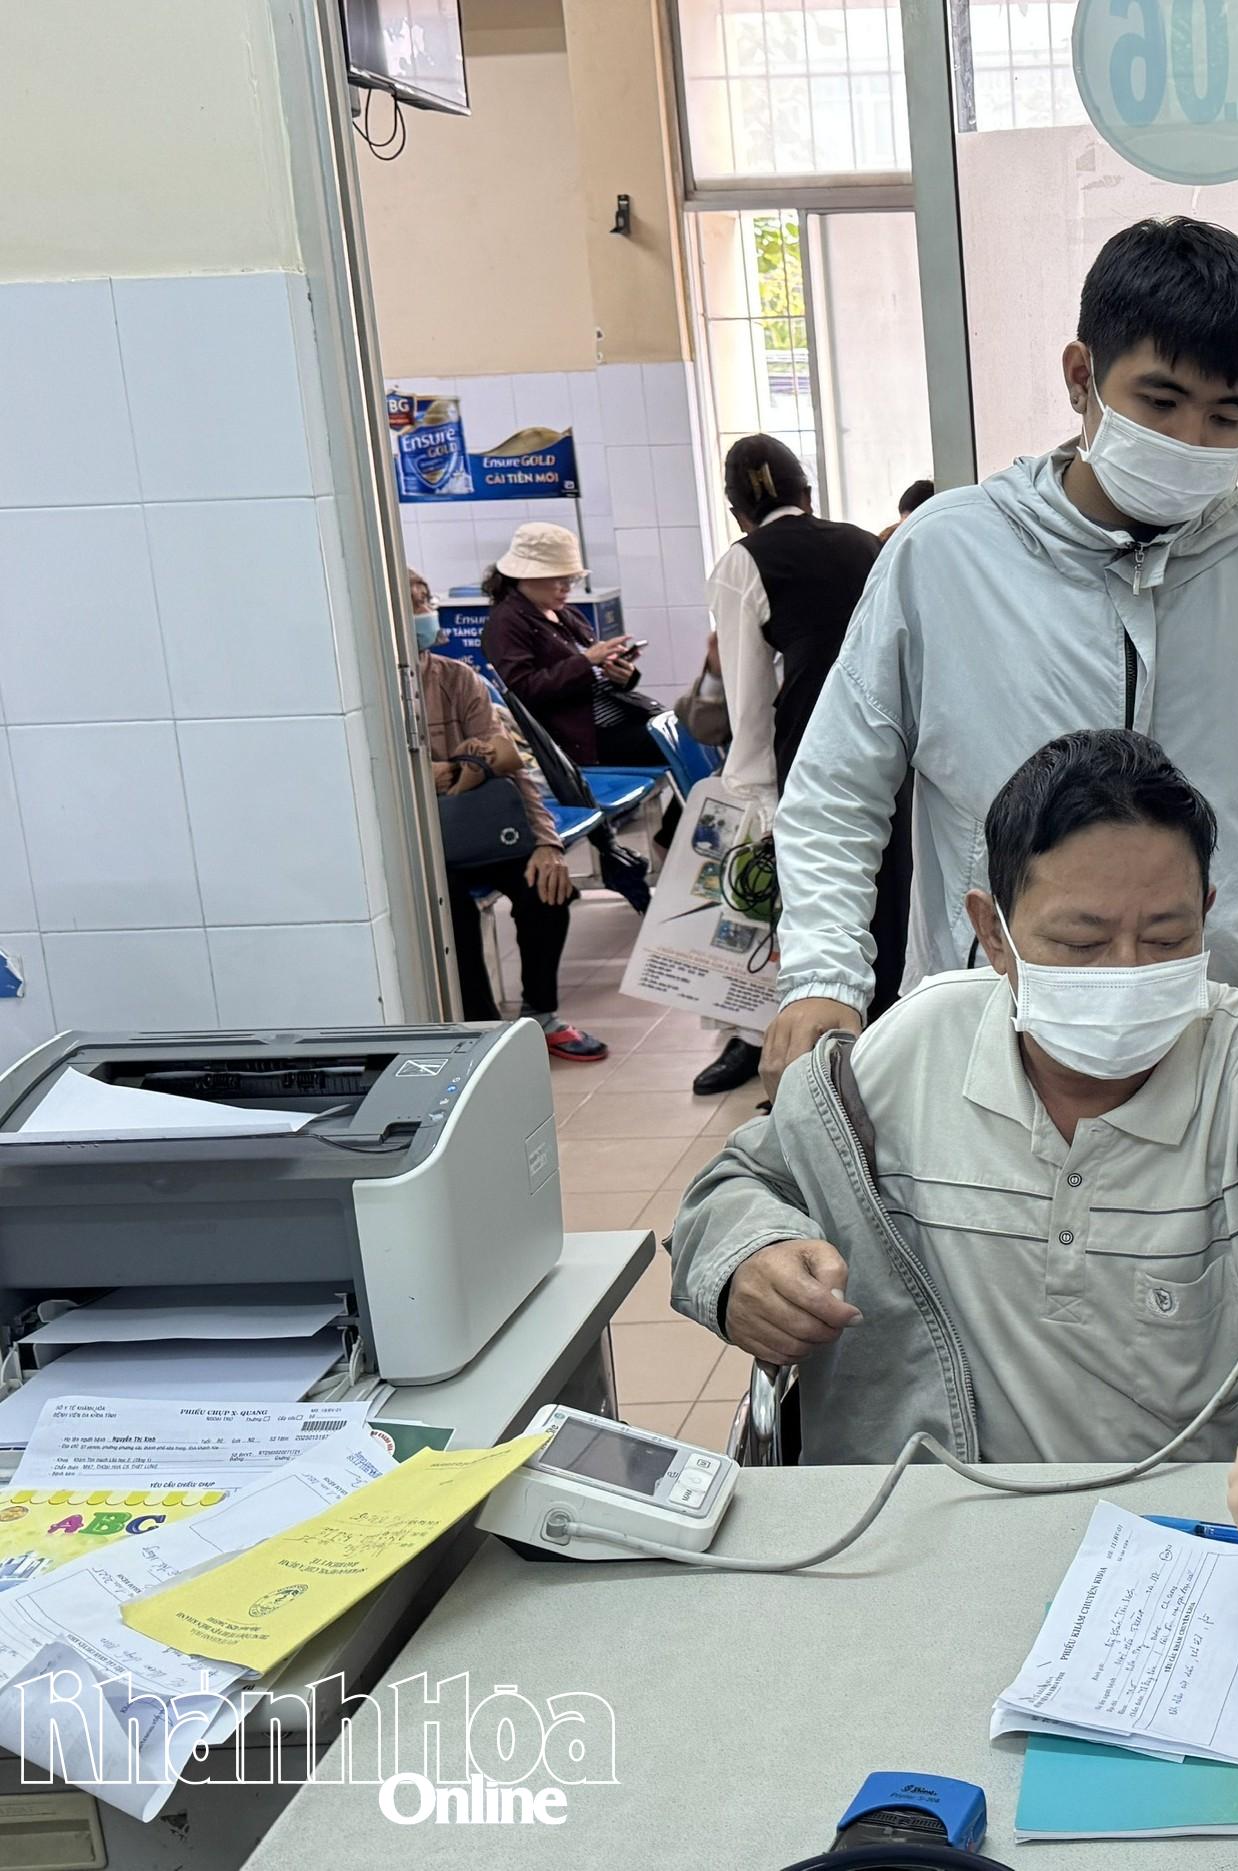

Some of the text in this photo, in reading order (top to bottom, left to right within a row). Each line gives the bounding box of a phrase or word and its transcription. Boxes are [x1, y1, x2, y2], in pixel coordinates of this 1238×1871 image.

[402, 428, 456, 452] Ensure
[428, 442, 458, 458] GOLD
[48, 1512, 166, 1536] ABC
[1060, 1639, 1076, 1661] PHIẾU
[1071, 1616, 1086, 1638] KHÁM
